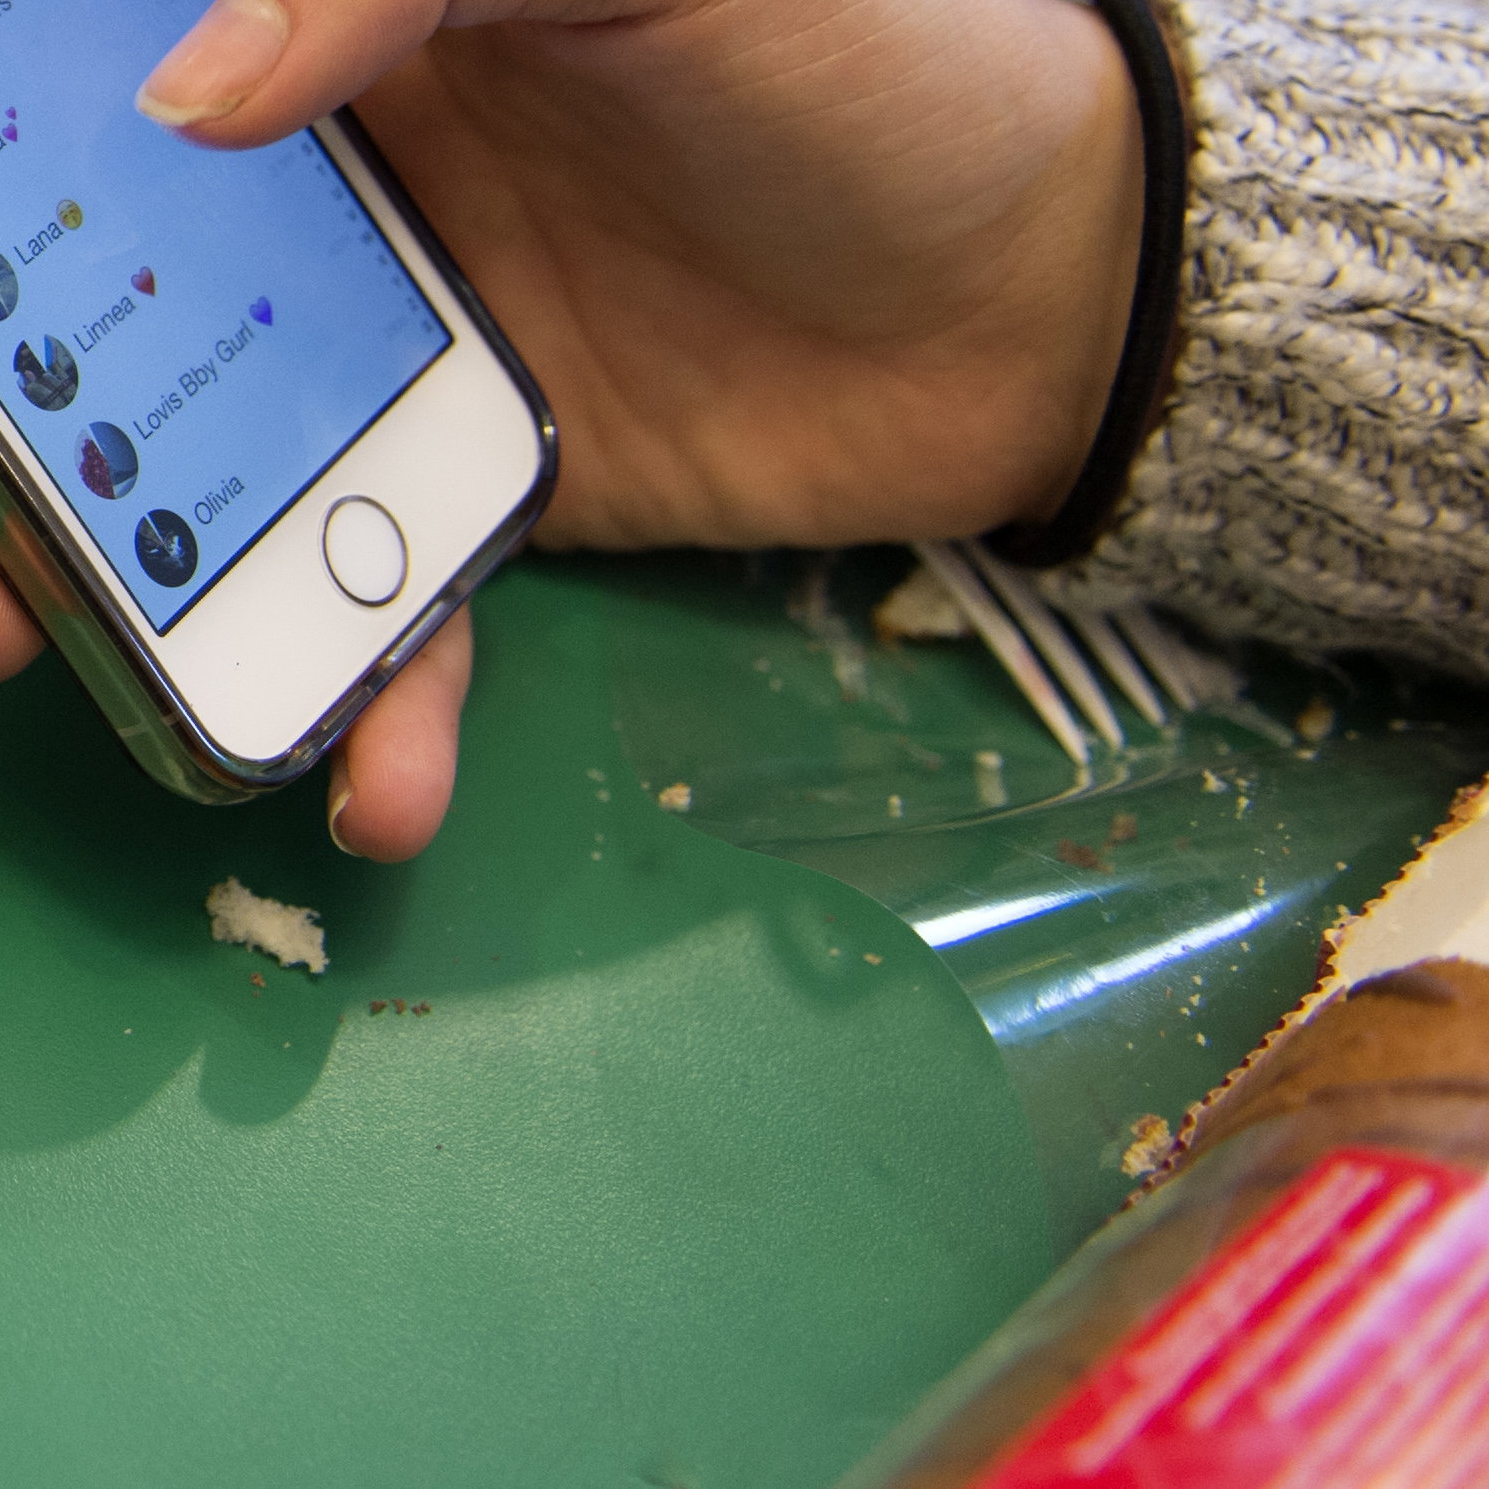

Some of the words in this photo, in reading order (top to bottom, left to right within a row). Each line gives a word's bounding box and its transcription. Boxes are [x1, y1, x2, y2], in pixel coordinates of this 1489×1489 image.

[13, 219, 65, 266] Lana
[73, 295, 137, 353] Linnea
[132, 388, 184, 441] Lovis
[178, 355, 220, 400] Bby
[214, 319, 256, 367] Gurl
[193, 473, 246, 527] Olivia
